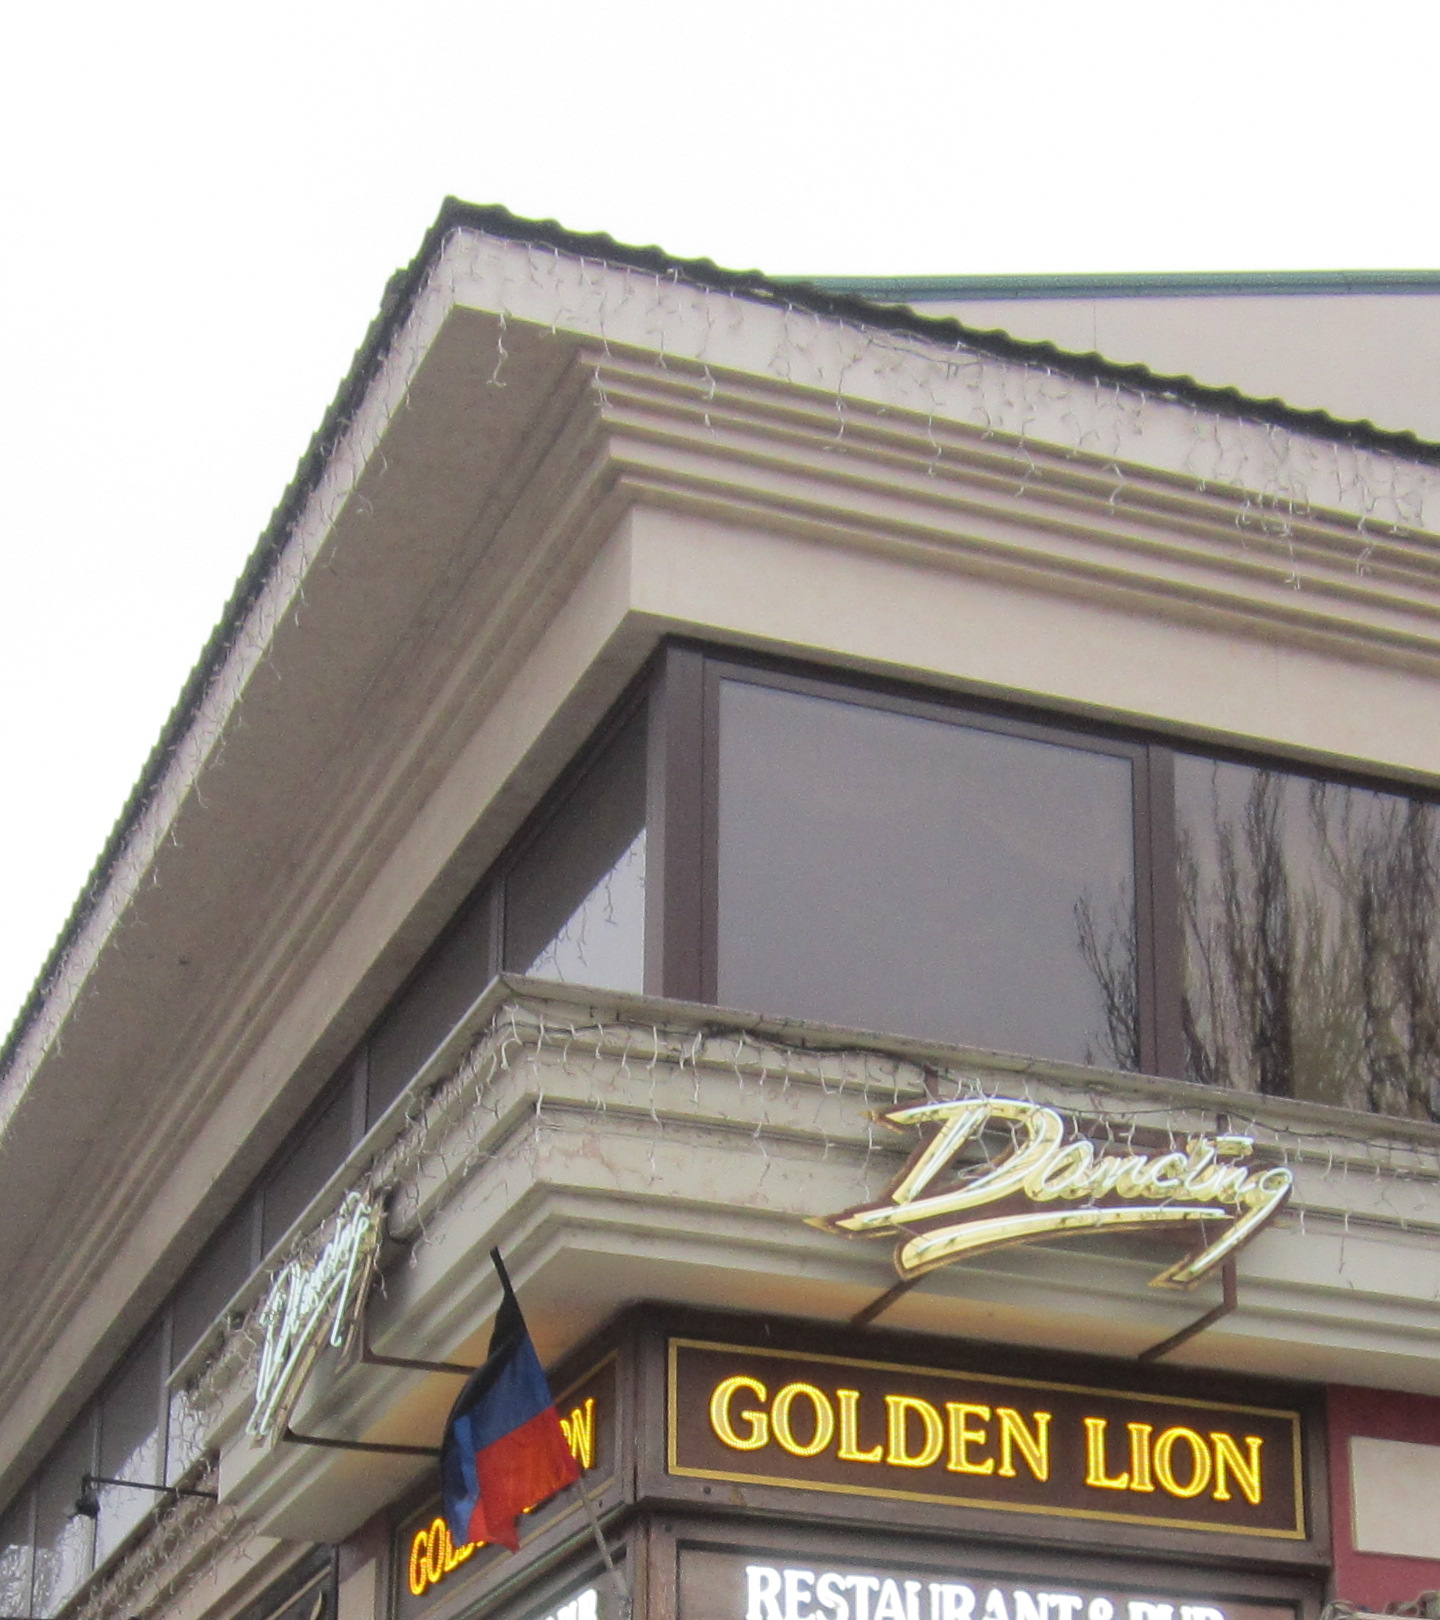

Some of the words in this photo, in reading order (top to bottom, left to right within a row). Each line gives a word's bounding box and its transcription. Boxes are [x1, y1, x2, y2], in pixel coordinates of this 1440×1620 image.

[836, 1096, 1294, 1284] Dancing
[710, 1376, 1052, 1482] GOLDEN
[1083, 1416, 1263, 1505] LION
